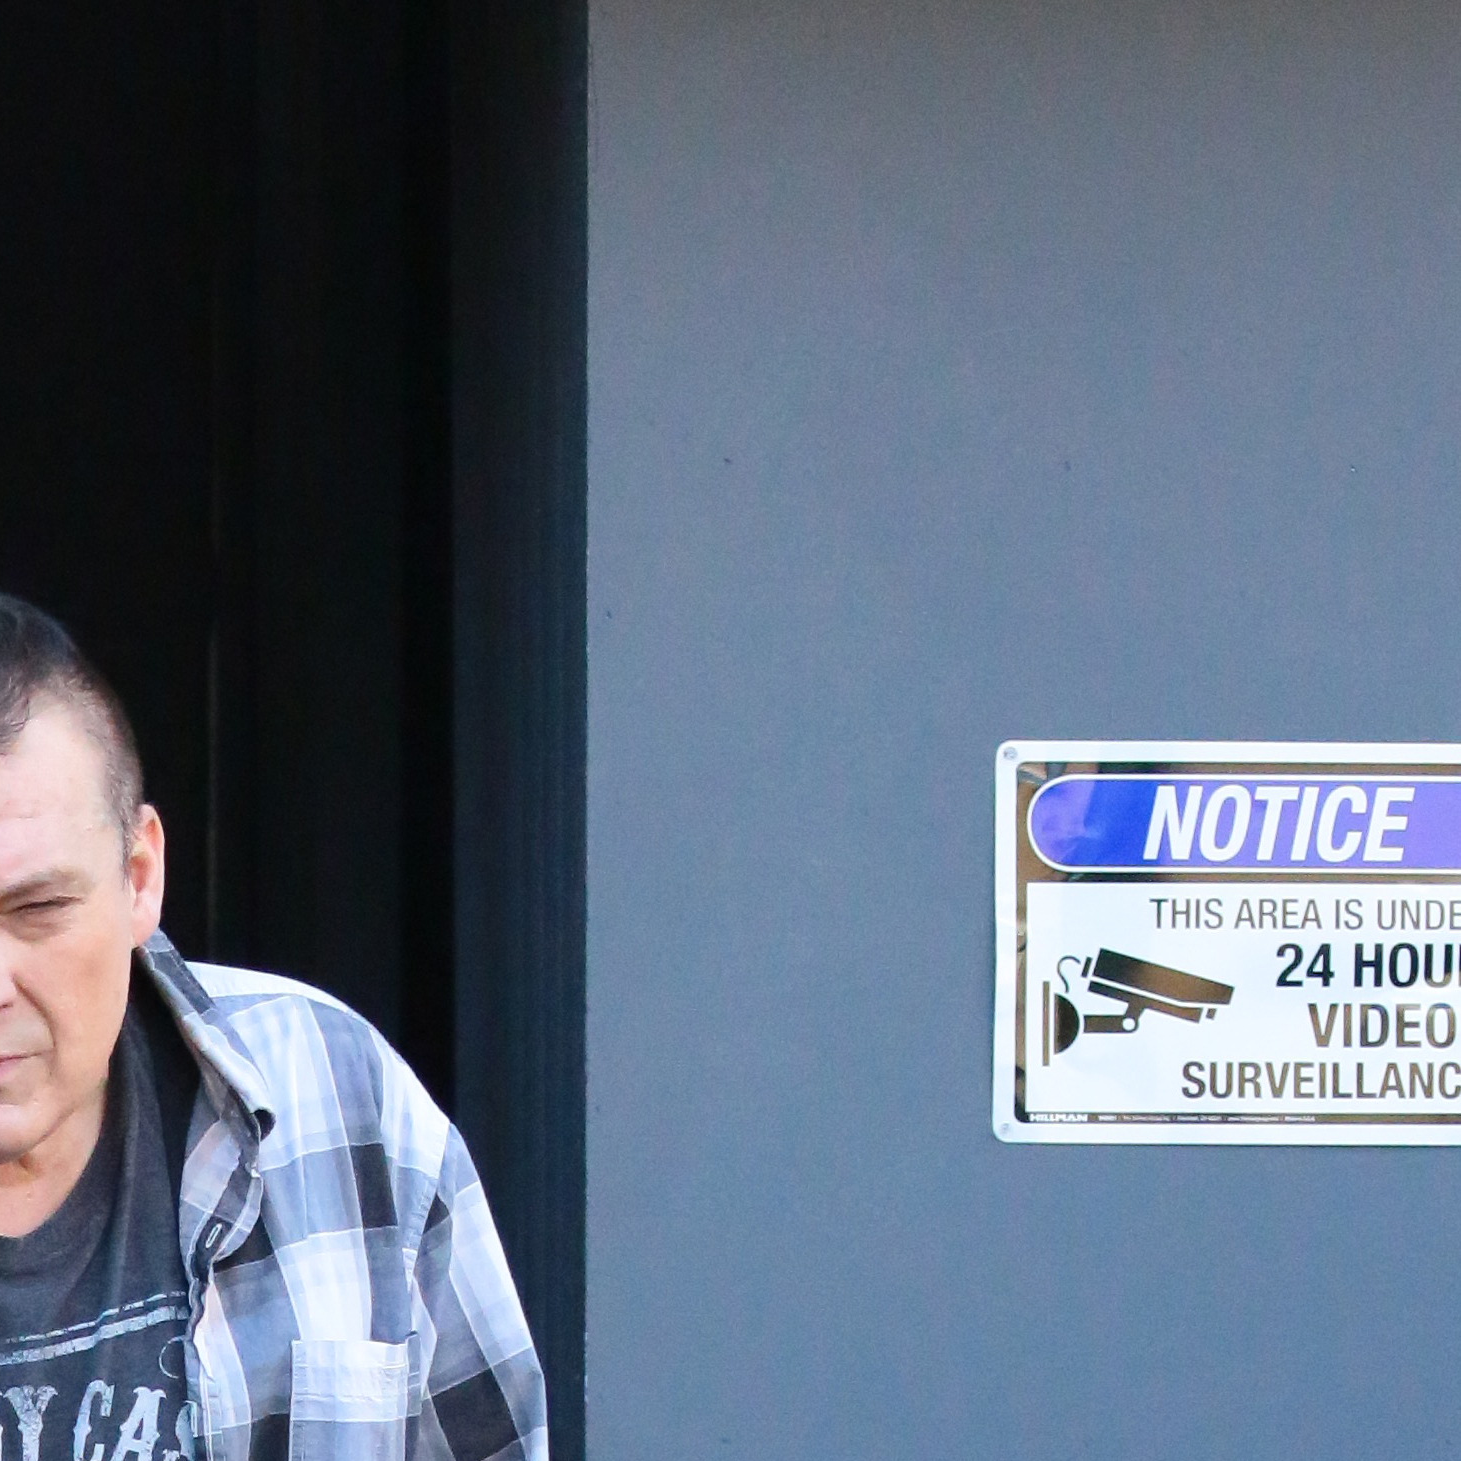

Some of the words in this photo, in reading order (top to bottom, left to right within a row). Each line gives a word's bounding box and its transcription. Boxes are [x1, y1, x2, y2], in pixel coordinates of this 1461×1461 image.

[1142, 784, 1416, 863] NOTICE
[1149, 898, 1224, 930] THIS
[1234, 898, 1323, 931] AREA
[1334, 898, 1364, 931] IS
[1377, 899, 1461, 931] UNDE
[1275, 942, 1335, 988] 24
[1353, 942, 1461, 989] HOU
[1307, 1002, 1457, 1050] VIDEO
[1182, 1061, 1461, 1100] SURVEILLANC
[1029, 1112, 1089, 1122] HILLMAN
